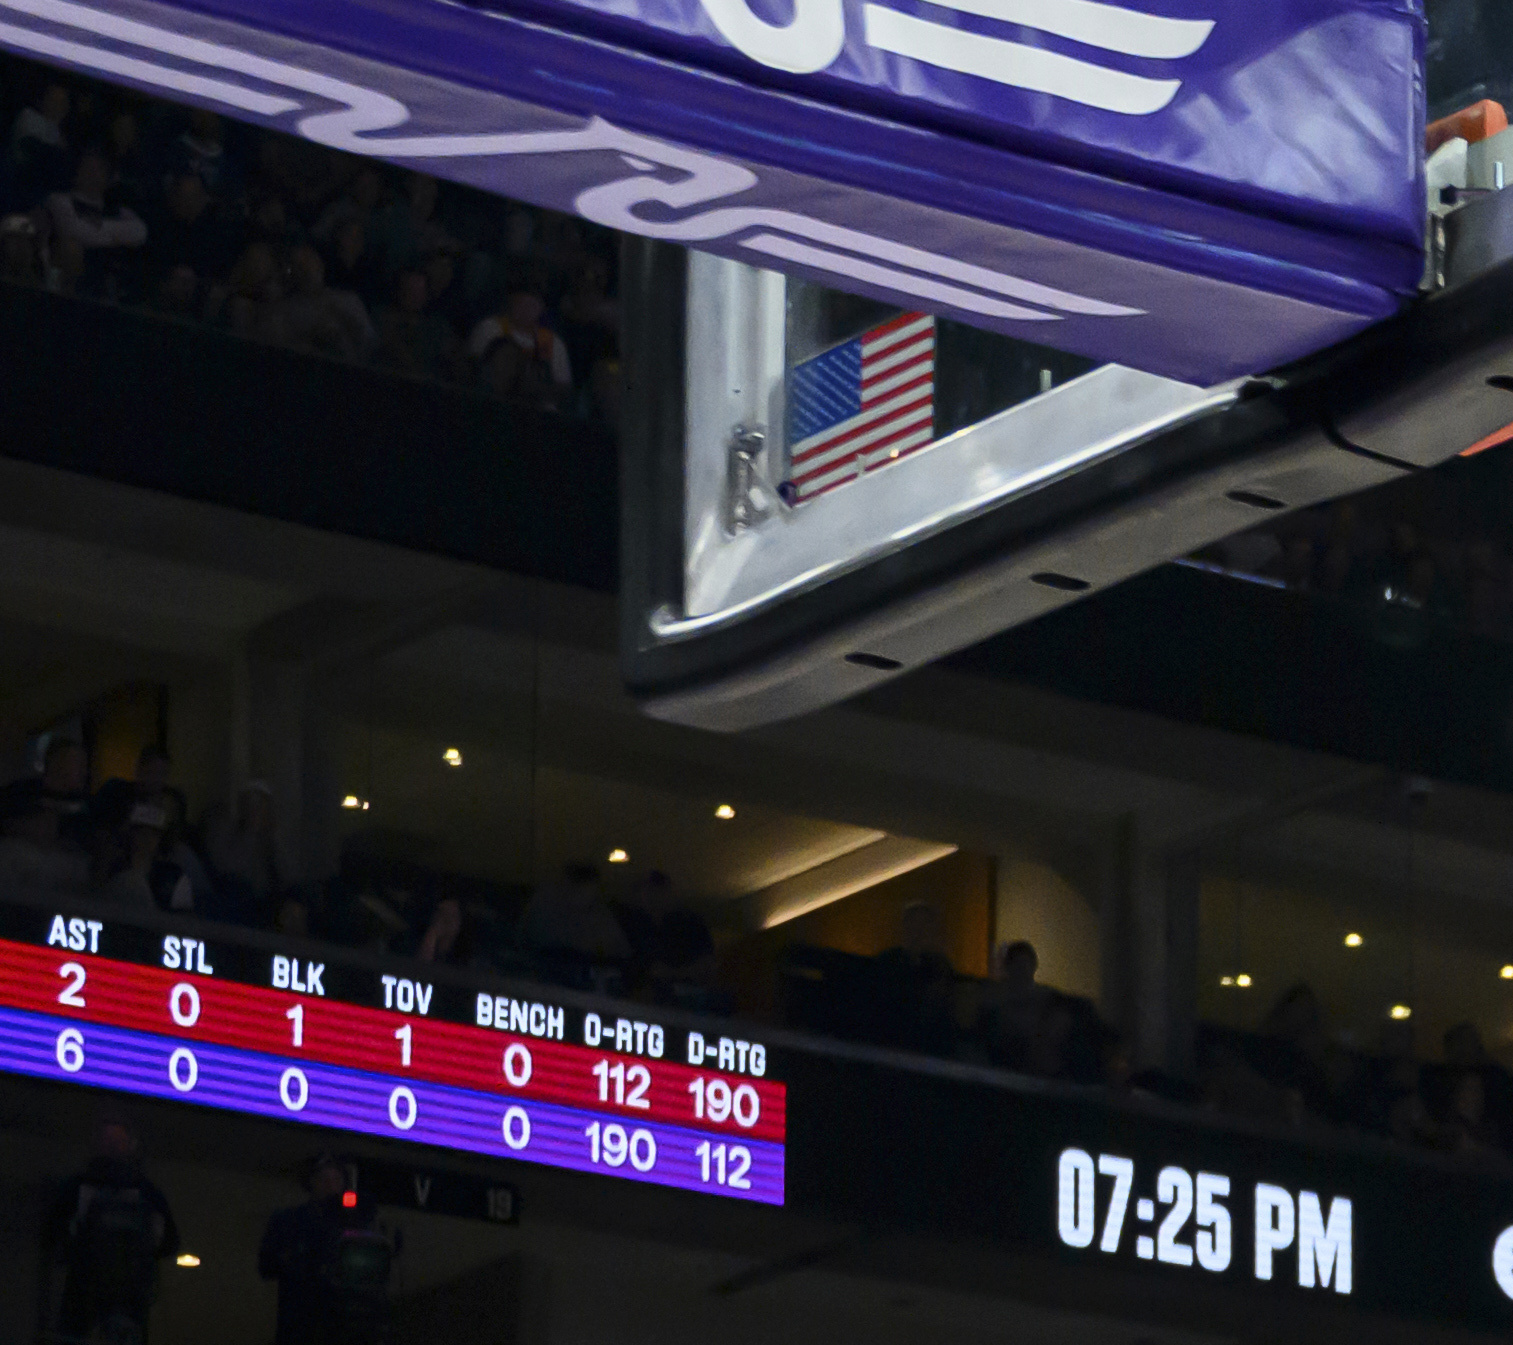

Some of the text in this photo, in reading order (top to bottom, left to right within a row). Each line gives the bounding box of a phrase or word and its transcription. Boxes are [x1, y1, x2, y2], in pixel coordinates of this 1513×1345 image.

[48, 914, 103, 954] AST
[163, 935, 213, 975] STL
[272, 955, 325, 996] BLK
[381, 975, 433, 1015] TOV
[476, 993, 564, 1040] BENCH
[687, 1032, 767, 1077] D-RTG
[57, 962, 760, 1128] 2 0 1 1 0 112 190
[56, 1027, 752, 1190] 6 0 0 0 0 190 112
[1058, 1147, 1353, 1295] 07:25 PM
